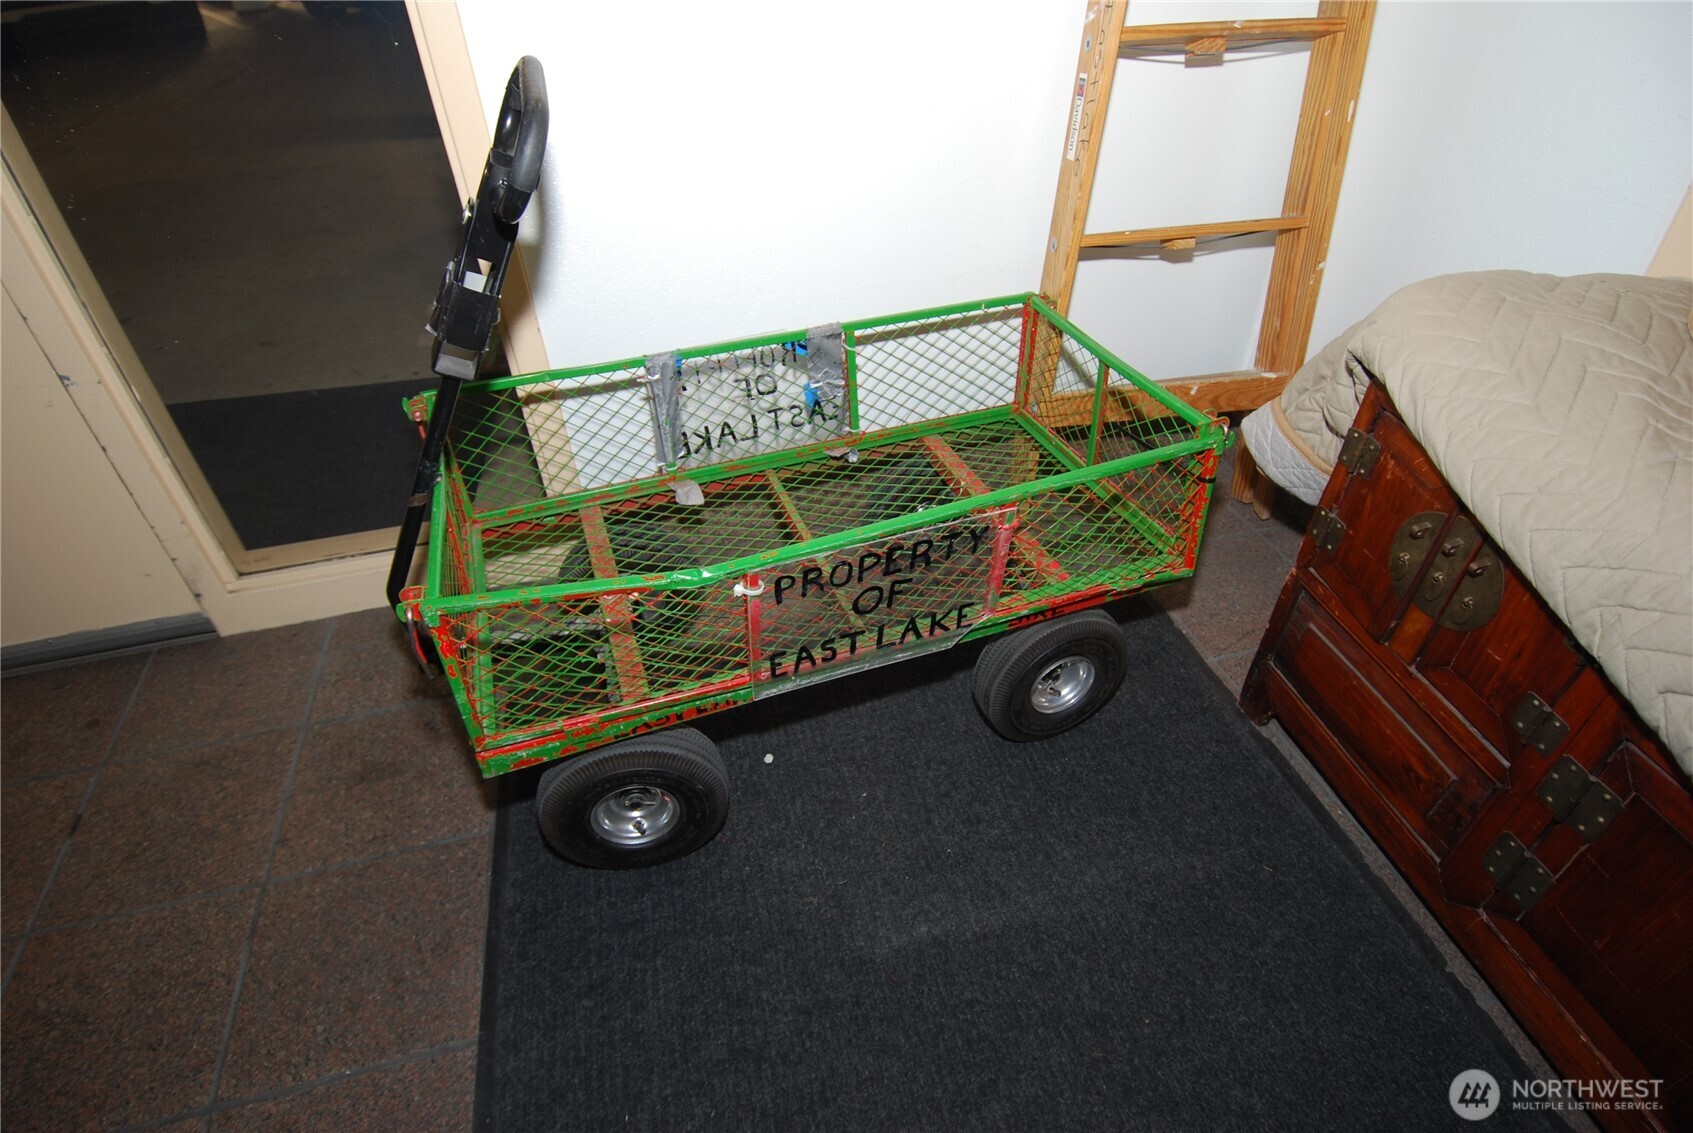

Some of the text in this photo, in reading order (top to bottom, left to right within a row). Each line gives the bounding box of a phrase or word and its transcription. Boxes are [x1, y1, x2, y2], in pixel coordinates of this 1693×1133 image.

[1069, 97, 1082, 151] Davidson
[774, 525, 990, 605] PROPERTY
[852, 578, 913, 615] OF
